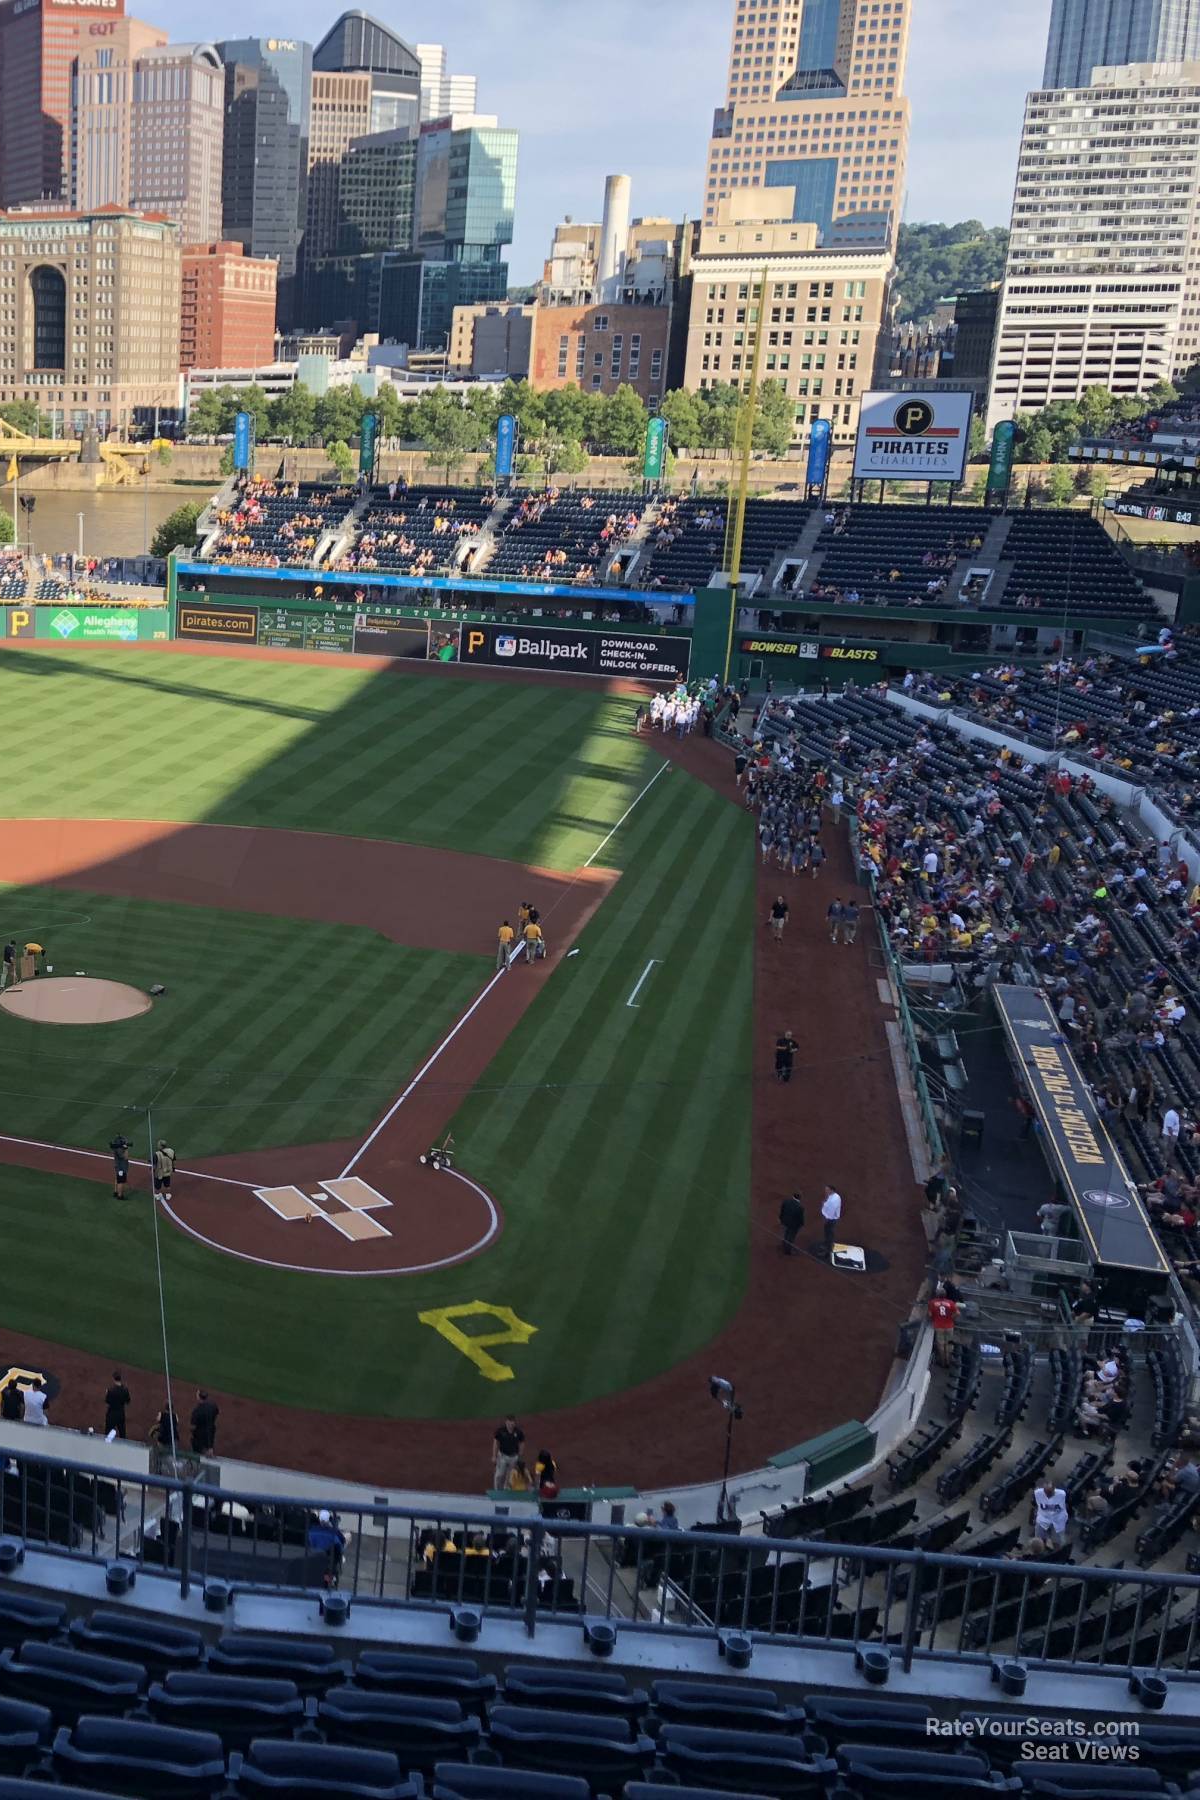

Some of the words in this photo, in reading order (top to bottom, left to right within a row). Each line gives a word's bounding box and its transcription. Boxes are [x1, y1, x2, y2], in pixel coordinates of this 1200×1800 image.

[89, 22, 117, 35] EQT
[278, 40, 297, 51] PNC
[905, 407, 924, 430] P
[872, 441, 950, 454] PIRATES
[870, 455, 949, 466] CHARITIES
[186, 614, 249, 630] pirates.com
[335, 604, 402, 615] WELCOME
[414, 609, 430, 617] TO
[441, 611, 468, 620] PNC
[480, 614, 519, 623] PARK
[11, 611, 29, 636] P
[83, 616, 137, 629] Allegheny
[468, 631, 485, 654] P
[518, 638, 588, 660] Ballpark
[601, 639, 658, 651] DOWNLOAD.
[750, 641, 798, 654] BOWSER
[801, 643, 817, 655] 33
[831, 647, 878, 660] BLASTS
[600, 649, 647, 660] CHECK-IN.
[600, 659, 637, 670] UNLOCK
[639, 663, 679, 673] OFFERS.
[1029, 1044, 1065, 1072] PARK
[1040, 1071, 1075, 1095] PNC
[1053, 1094, 1077, 1106] TO
[1055, 1106, 1106, 1164] WELCOME
[417, 1299, 539, 1381] P
